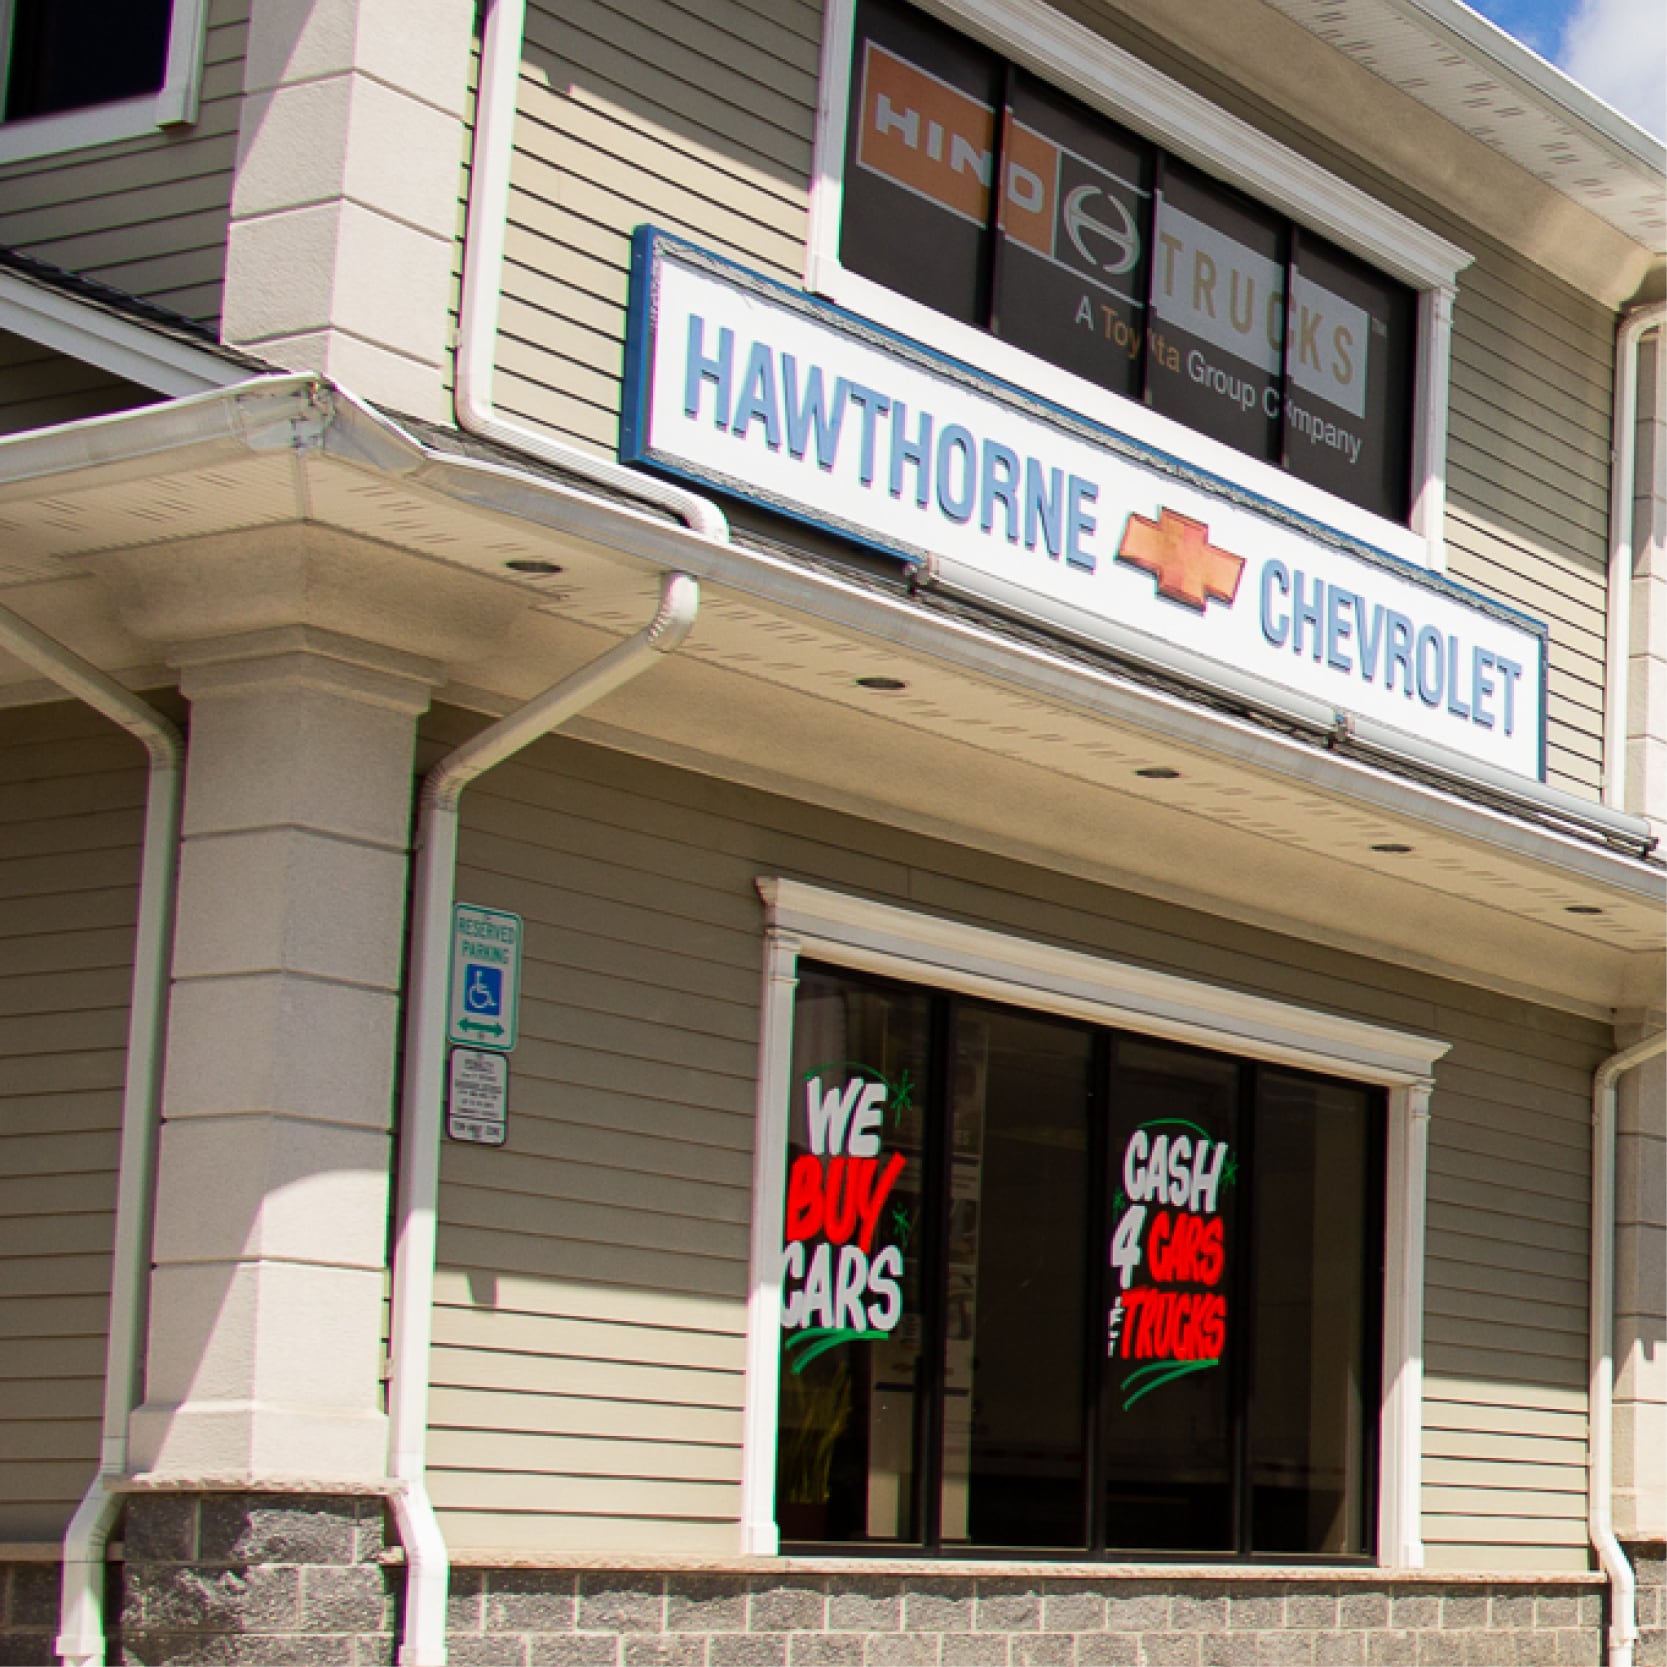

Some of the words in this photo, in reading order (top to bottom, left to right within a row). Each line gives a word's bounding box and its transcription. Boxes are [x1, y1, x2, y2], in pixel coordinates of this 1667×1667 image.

[875, 92, 1044, 213] HINO
[1159, 230, 1354, 386] TRUCKS
[1074, 295, 1095, 331] A
[1102, 304, 1180, 373] Toyta
[1188, 350, 1256, 412] Group
[1262, 386, 1362, 464] Cmpany
[684, 312, 1099, 575] HAWTHORNE
[1260, 557, 1522, 737] CHEVROLET
[458, 916, 515, 945] RESERVED
[462, 939, 509, 964] PARKING
[806, 1075, 889, 1158] WE
[786, 1151, 907, 1255] BUY
[1122, 1129, 1229, 1214] CASH
[781, 1239, 904, 1333] CARS
[1110, 1204, 1148, 1290] 4
[1147, 1210, 1224, 1286] CARS
[1119, 1285, 1227, 1361] TRUCKS
